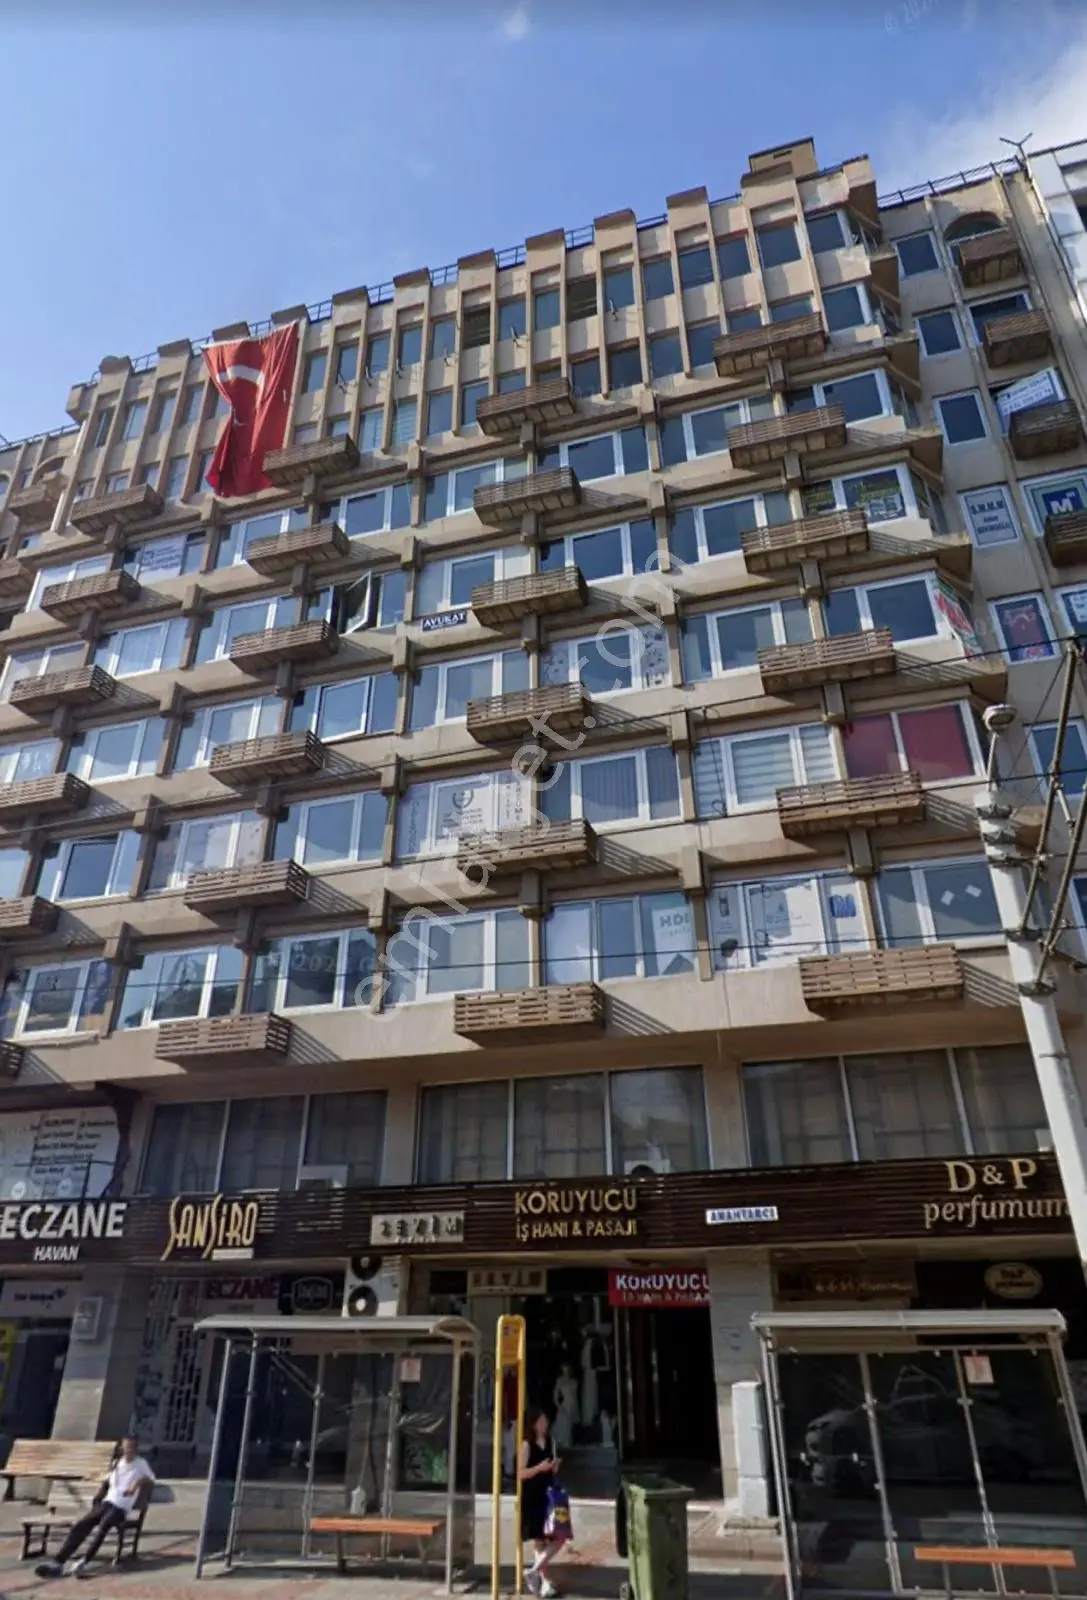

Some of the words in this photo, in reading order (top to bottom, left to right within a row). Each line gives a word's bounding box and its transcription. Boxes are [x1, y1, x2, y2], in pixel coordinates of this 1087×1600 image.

[423, 612, 464, 628] AVUKAT
[515, 1188, 637, 1214] KORUYUCU
[0, 1202, 127, 1239] ECZANE
[516, 1218, 529, 1242] İŞ
[532, 1222, 568, 1238] HANI
[572, 1221, 582, 1236] &
[586, 1220, 637, 1237] PASAJI
[34, 1245, 80, 1261] HAVAN
